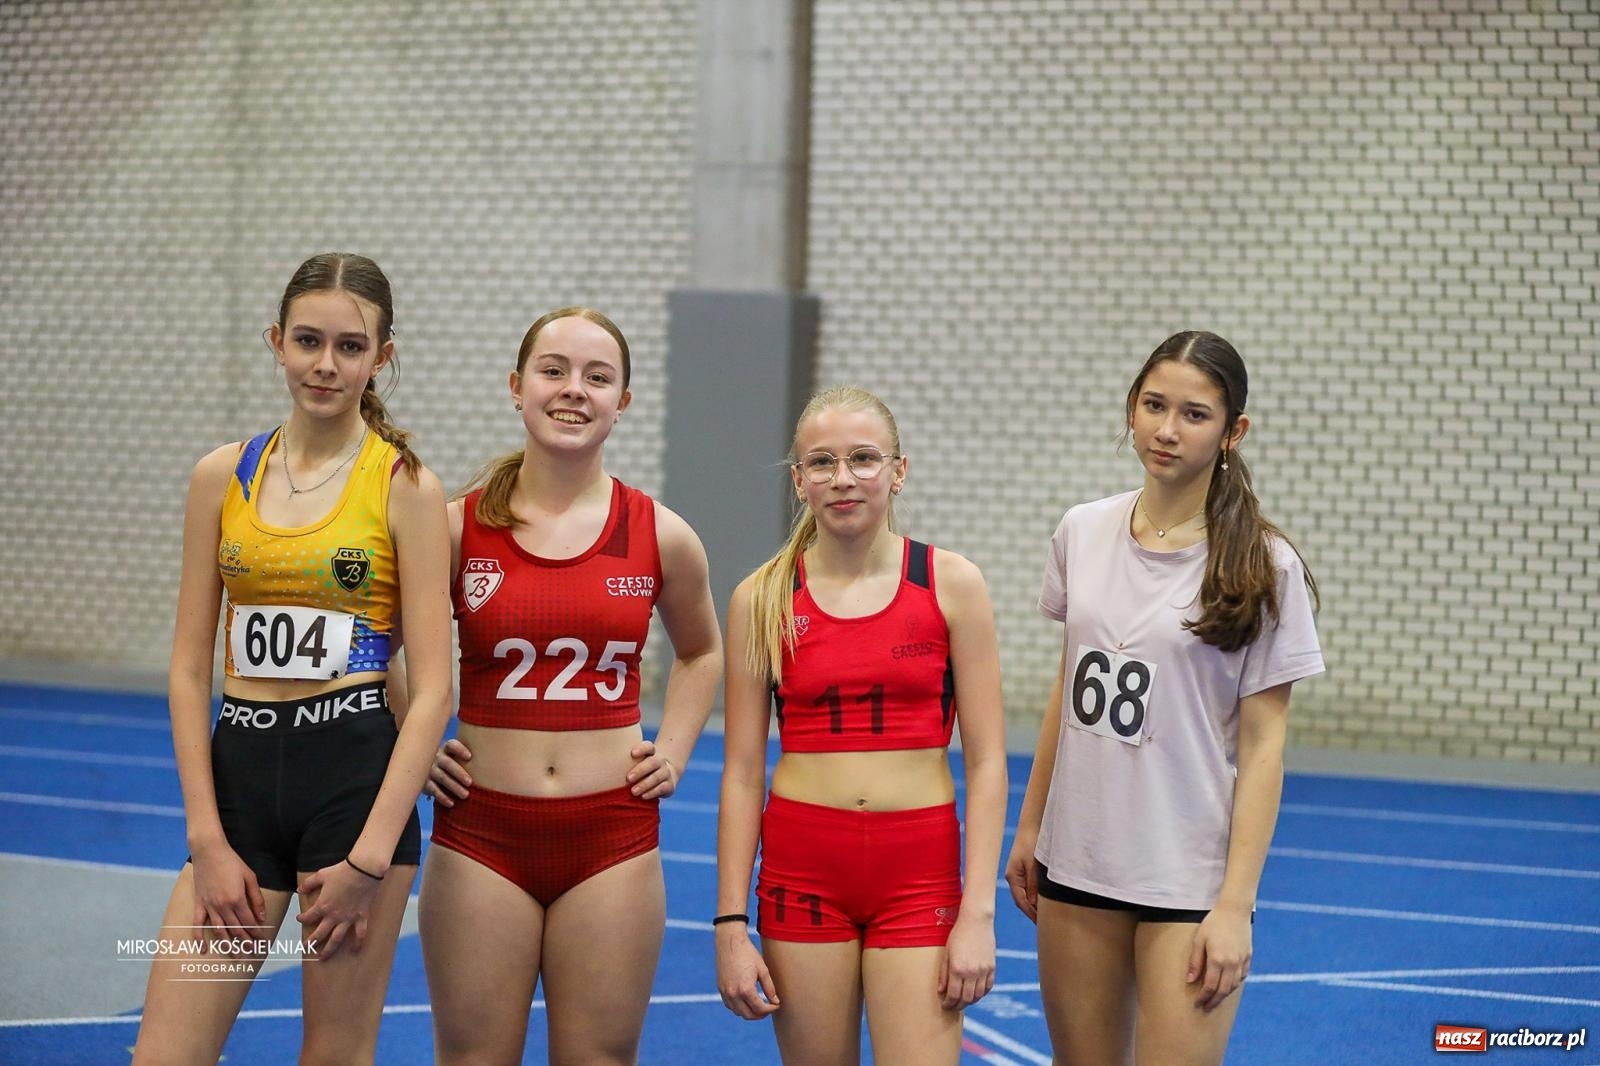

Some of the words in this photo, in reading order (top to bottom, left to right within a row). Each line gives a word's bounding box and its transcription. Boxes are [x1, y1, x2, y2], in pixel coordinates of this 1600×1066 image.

[340, 550, 362, 560] CKS
[470, 562, 494, 571] CKS
[245, 612, 328, 668] 604
[493, 637, 638, 702] 225
[218, 702, 278, 729] PRO
[293, 688, 381, 728] NIKE
[812, 684, 885, 735] 11
[1072, 650, 1151, 737] 68
[767, 886, 823, 927] 11
